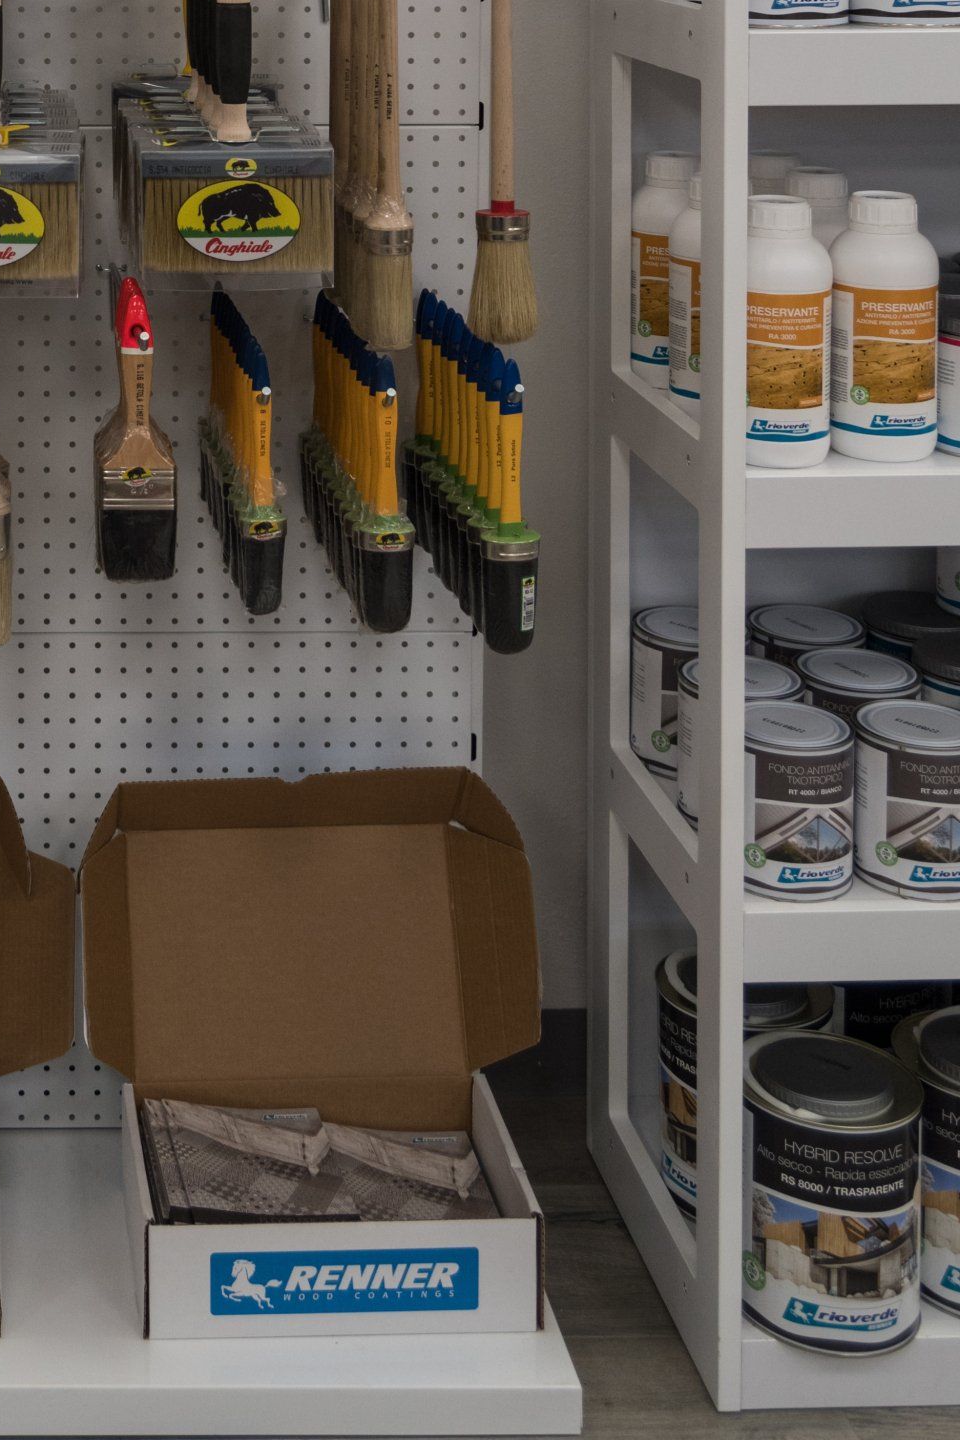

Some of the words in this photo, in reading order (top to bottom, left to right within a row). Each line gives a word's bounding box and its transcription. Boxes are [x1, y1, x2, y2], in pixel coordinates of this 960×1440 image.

[205, 237, 273, 257] Cinghiale
[861, 301, 935, 313] PRESERVANTE
[856, 318, 877, 326] AZIONE
[768, 333, 780, 341] RA
[768, 763, 804, 775] FONDO
[900, 761, 937, 773] FONDO
[788, 788, 798, 796] RT
[799, 788, 815, 796] 4000
[821, 786, 842, 795] BIANCO
[784, 1138, 840, 1163] HYBRID
[844, 1144, 903, 1164] RESOLVE
[757, 1144, 775, 1160] Alto
[777, 1155, 813, 1175] secco
[825, 1166, 866, 1181] Rapida
[781, 1173, 795, 1186] RS
[798, 1179, 824, 1193] 8000
[834, 1179, 904, 1197] TRASPARENTE
[284, 1262, 460, 1292] RENNER
[283, 1292, 335, 1301] WOOD
[354, 1289, 457, 1299] COATINGS
